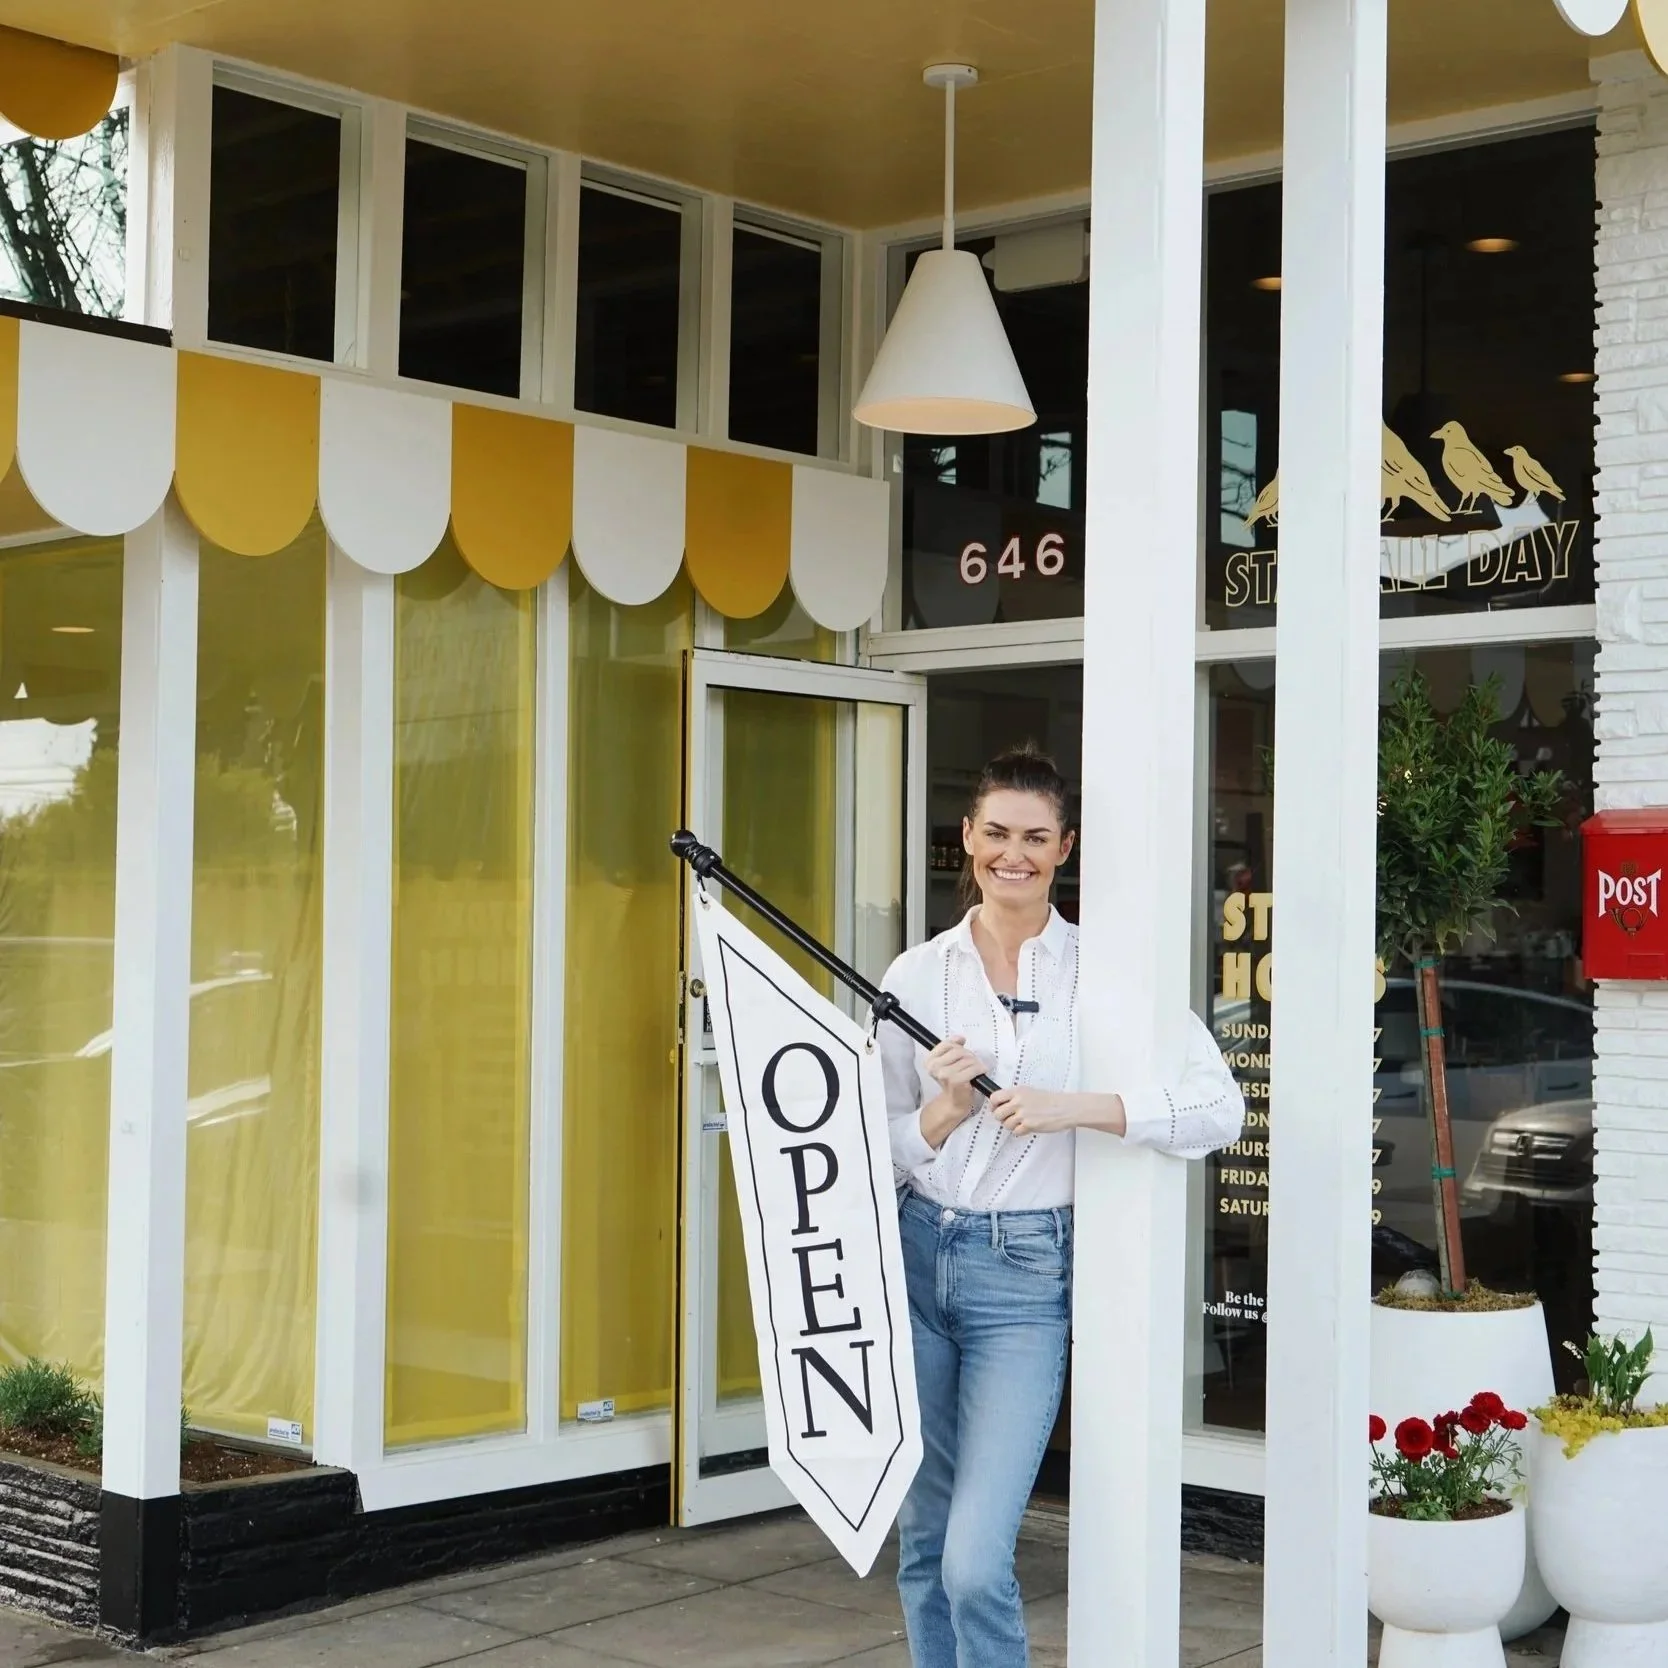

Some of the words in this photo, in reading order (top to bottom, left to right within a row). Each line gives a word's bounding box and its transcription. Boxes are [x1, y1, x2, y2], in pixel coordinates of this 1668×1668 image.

[959, 532, 1066, 585] 646
[1225, 549, 1277, 607] ST
[1466, 520, 1580, 587] DAY
[1597, 868, 1662, 918] POST
[1221, 1023, 1271, 1039] SUND
[1238, 1082, 1271, 1098] ESD
[1243, 1111, 1270, 1128] DN
[1220, 1168, 1270, 1187] FRIDA
[761, 1042, 875, 1438] OPEN
[1225, 1290, 1242, 1304] Be
[1243, 1292, 1264, 1307] the
[1202, 1302, 1242, 1318] Follow
[1244, 1309, 1259, 1320] us
